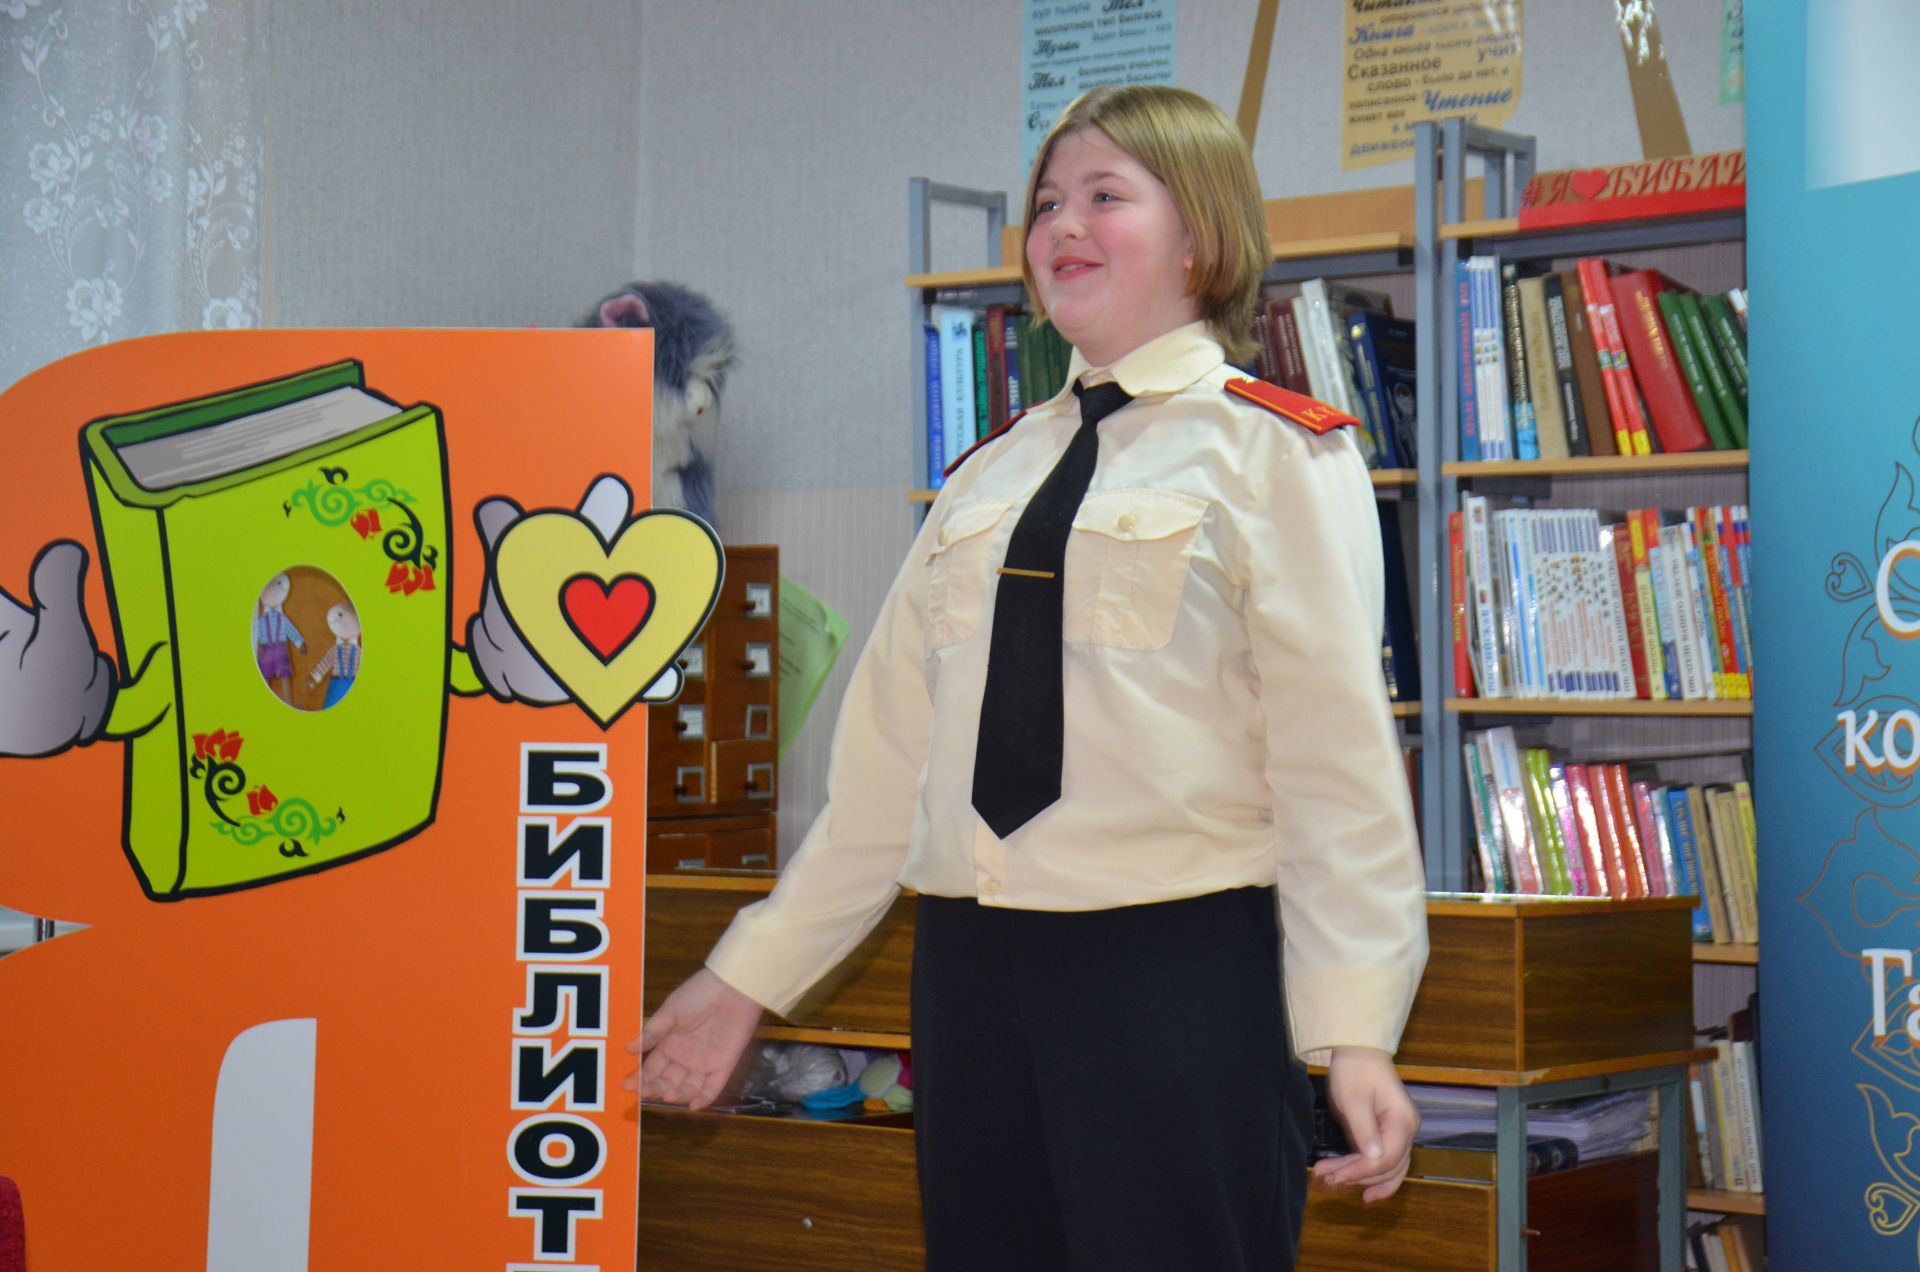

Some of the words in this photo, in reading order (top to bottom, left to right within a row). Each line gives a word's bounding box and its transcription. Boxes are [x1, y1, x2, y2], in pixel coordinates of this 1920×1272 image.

[1347, 56, 1442, 80] Сказанное
[1367, 77, 1412, 93] слово
[1423, 87, 1513, 112] Чтение
[508, 743, 612, 1272] БИБЛИОТ
